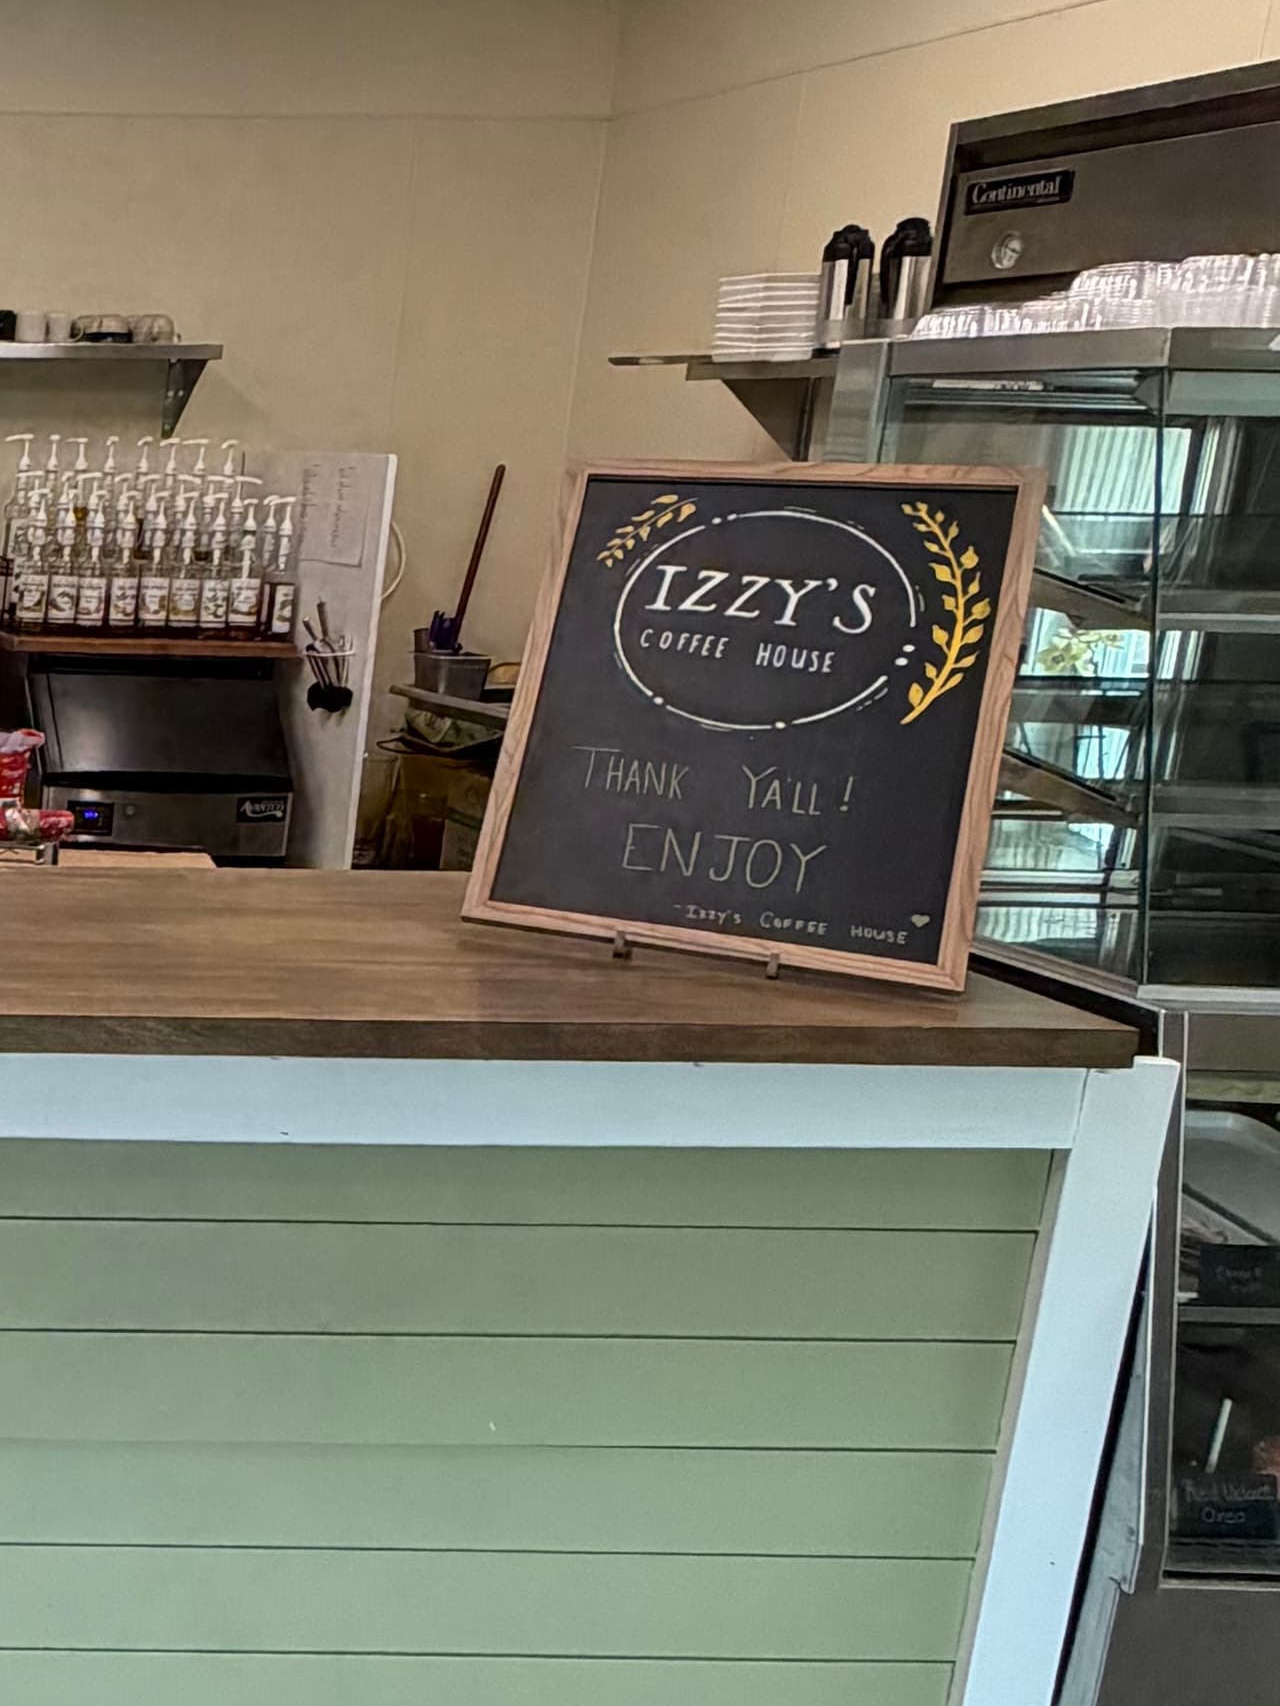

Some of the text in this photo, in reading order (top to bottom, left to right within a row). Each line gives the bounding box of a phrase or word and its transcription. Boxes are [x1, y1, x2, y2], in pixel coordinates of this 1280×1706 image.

[971, 175, 1063, 205] Continental
[644, 564, 876, 635] IZZY'S
[640, 628, 836, 673] COFFEE HOUSE
[572, 745, 690, 800] THANK
[622, 823, 828, 894] ENJOY
[760, 910, 828, 935] COFFEE
[851, 924, 908, 945] HOUSE
